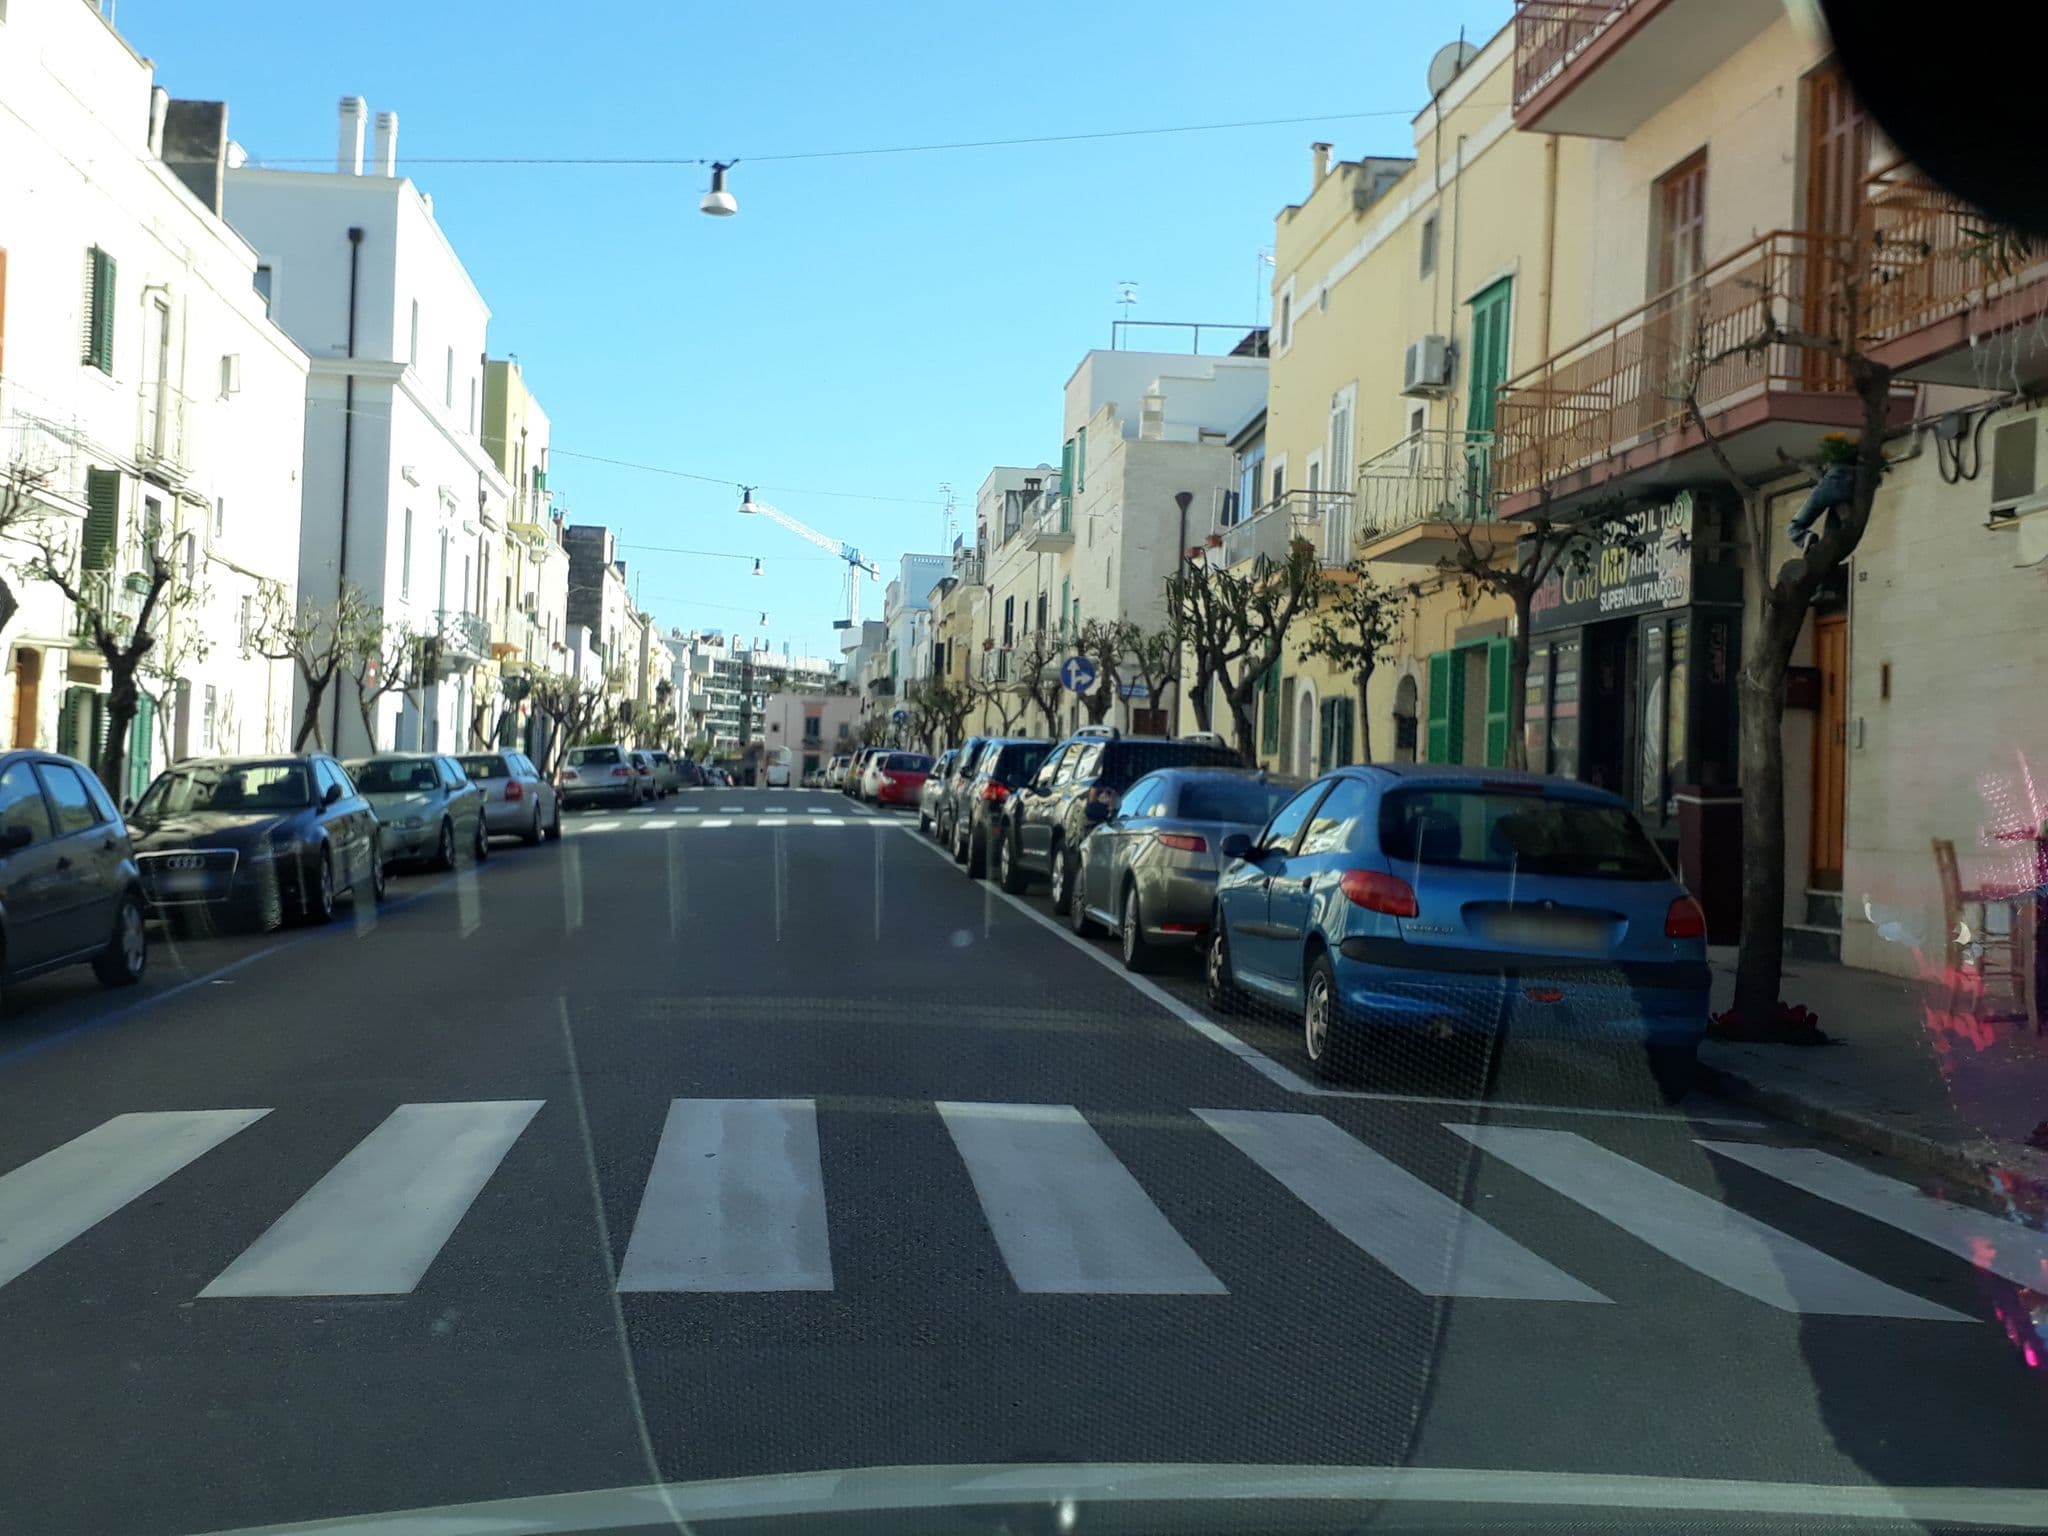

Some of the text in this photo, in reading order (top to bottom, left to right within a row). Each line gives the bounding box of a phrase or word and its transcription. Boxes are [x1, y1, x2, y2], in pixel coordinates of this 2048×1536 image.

[1647, 508, 1657, 531] IL
[1660, 501, 1684, 529] TUO
[1562, 559, 1599, 605] Gold
[1600, 547, 1628, 587] ORO
[1600, 575, 1683, 612] SUPERVALUTANDOLO
